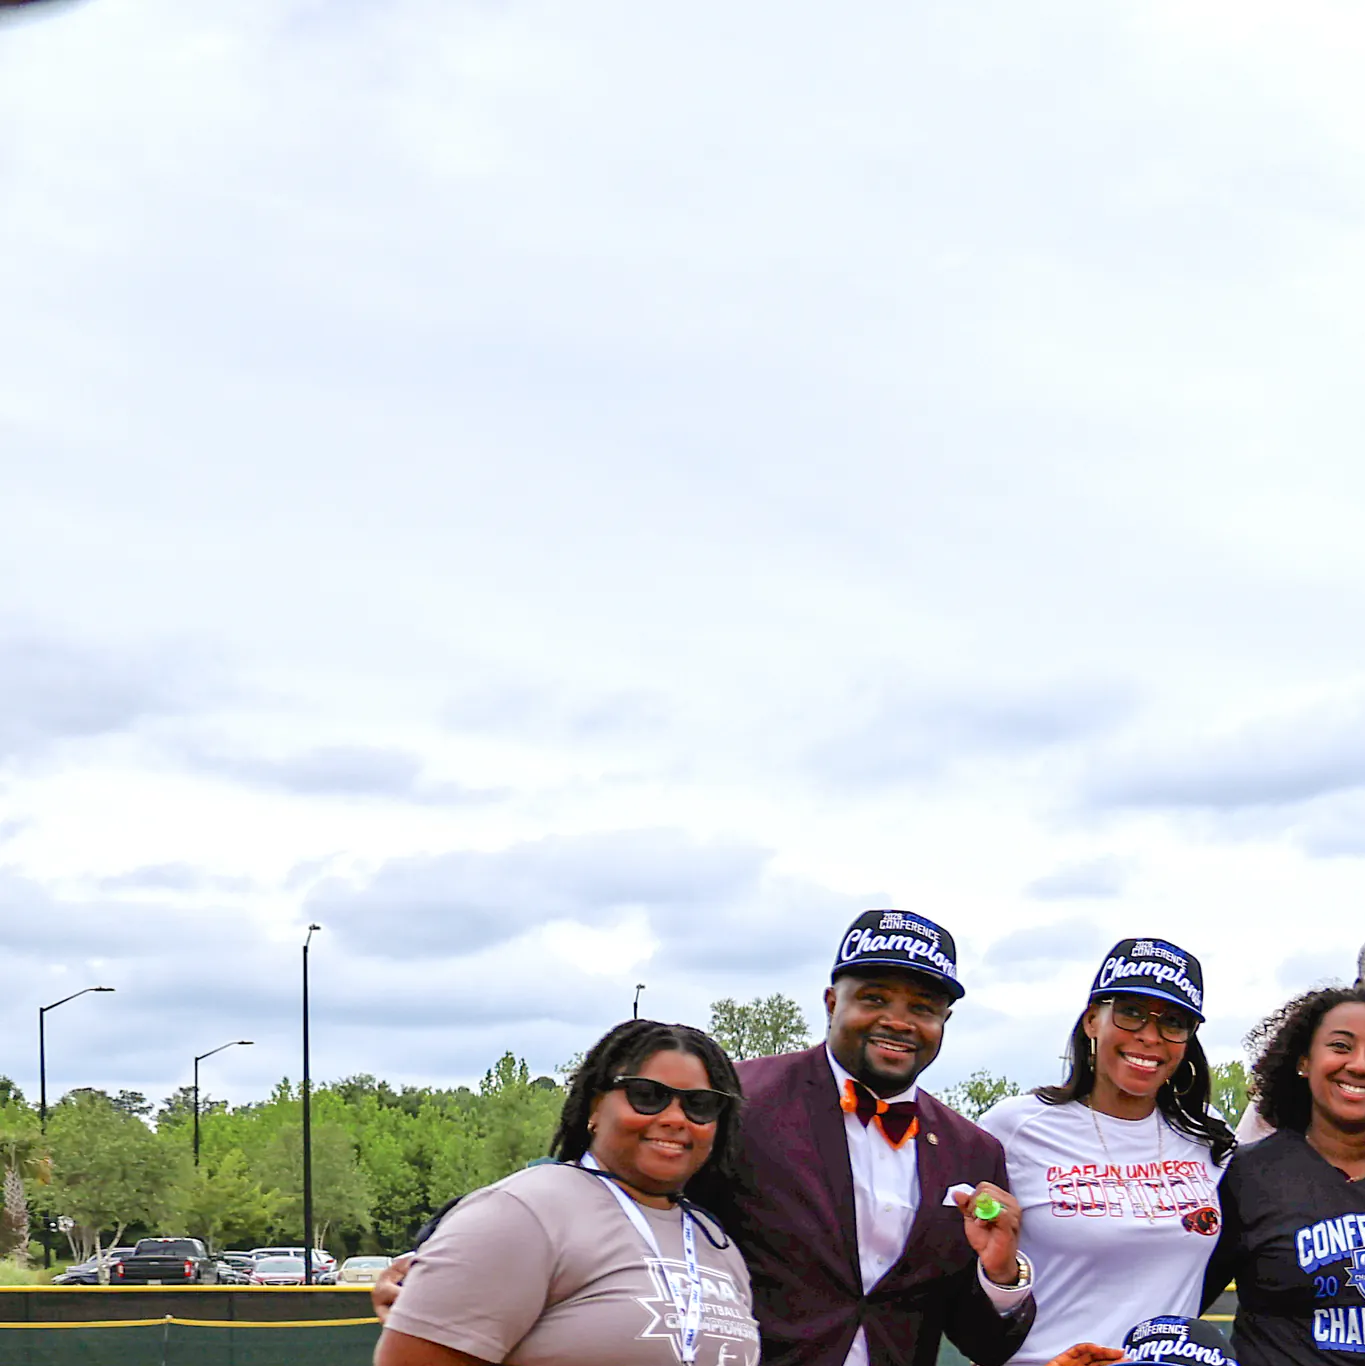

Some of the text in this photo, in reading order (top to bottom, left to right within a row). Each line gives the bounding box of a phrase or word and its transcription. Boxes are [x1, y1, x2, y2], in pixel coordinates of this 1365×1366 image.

[879, 920, 941, 942] CONFERENCE
[1131, 948, 1189, 971] CONFERENCE
[1047, 1160, 1207, 1182] CLAFLIN UNIVERSITY
[1313, 1276, 1338, 1298] 20
